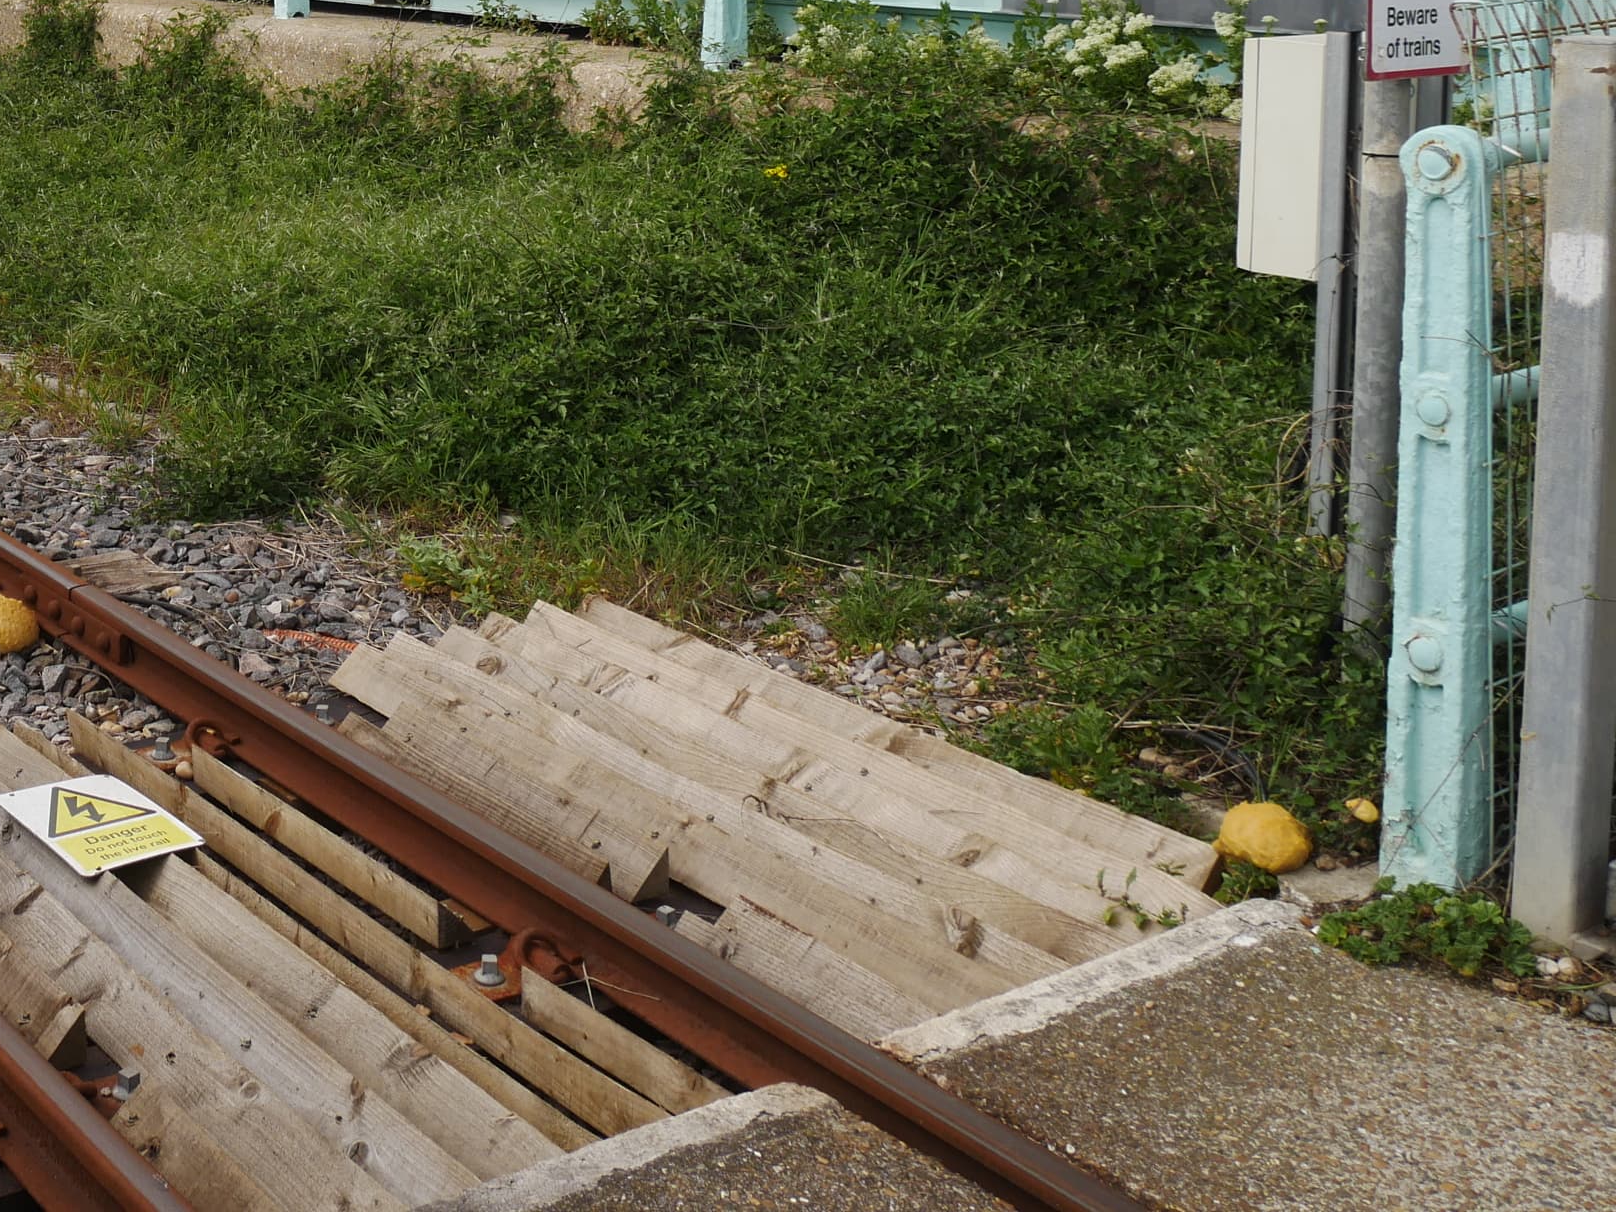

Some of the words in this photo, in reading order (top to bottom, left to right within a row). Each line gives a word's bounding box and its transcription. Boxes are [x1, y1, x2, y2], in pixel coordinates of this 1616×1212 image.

[1387, 7, 1439, 27] Beware
[1387, 38, 1401, 59] of
[1403, 37, 1441, 57] trains
[84, 824, 148, 845] Danger
[85, 846, 105, 855] Do
[107, 839, 130, 850] not
[130, 830, 168, 843] touch
[100, 851, 122, 861] the
[123, 844, 147, 854] live
[150, 837, 171, 848] rail
